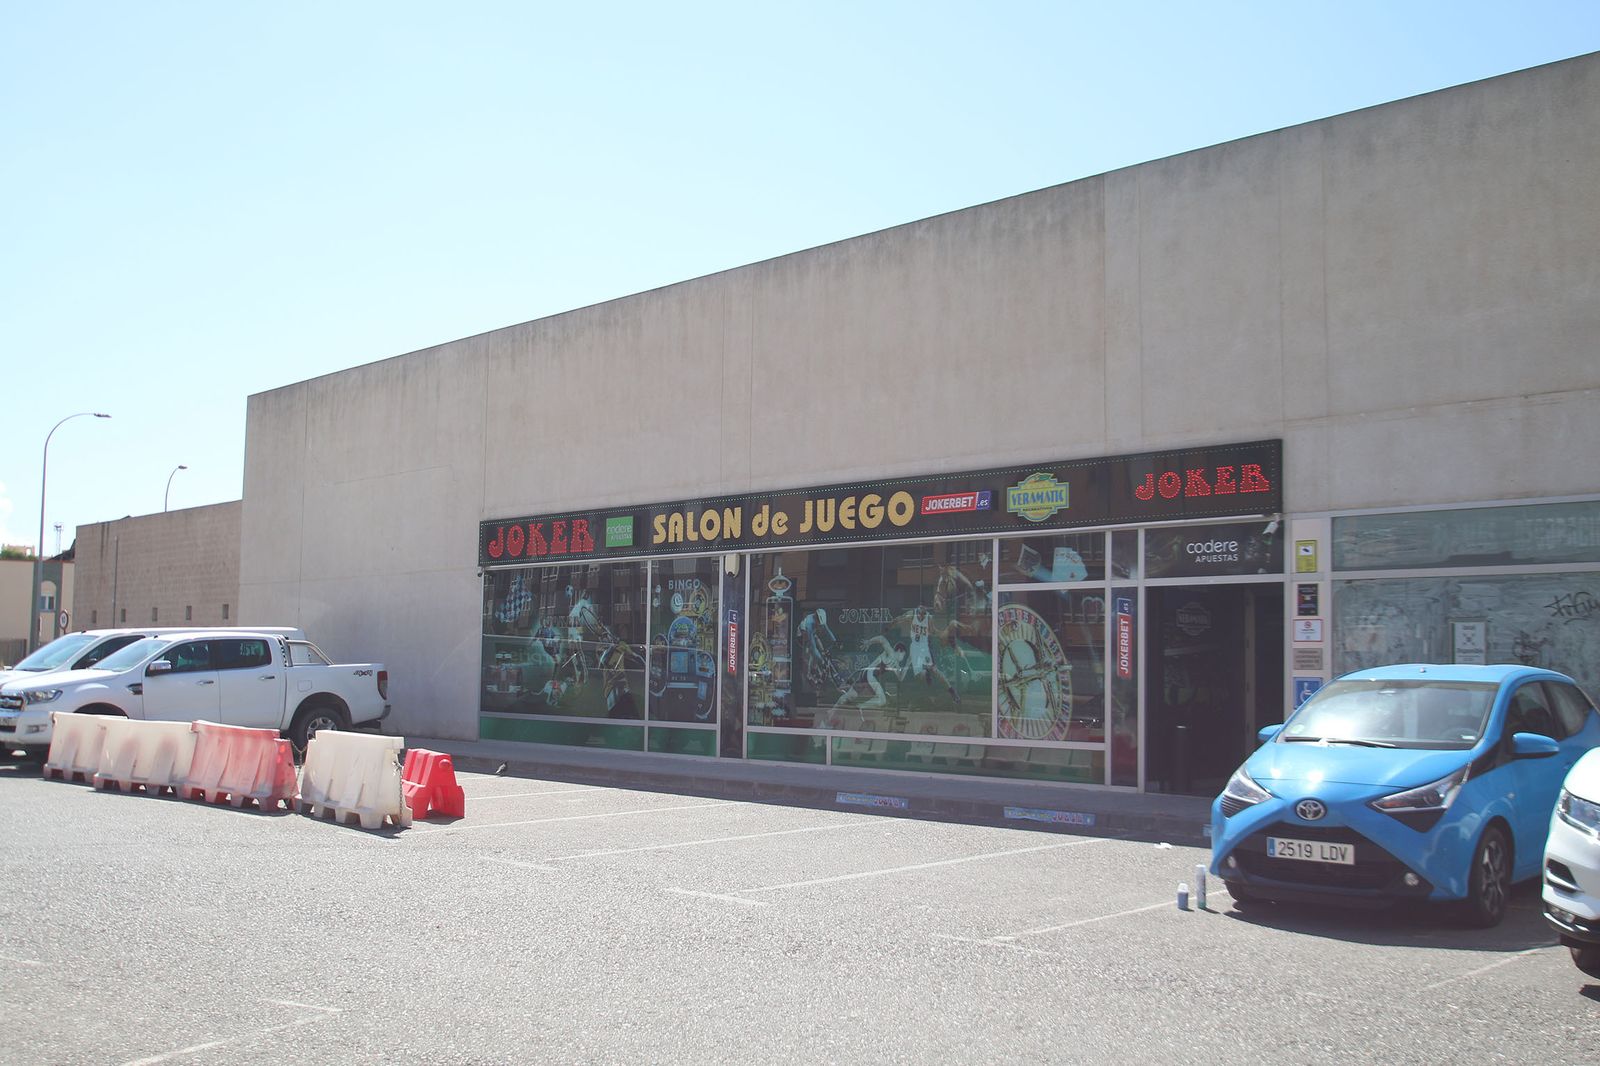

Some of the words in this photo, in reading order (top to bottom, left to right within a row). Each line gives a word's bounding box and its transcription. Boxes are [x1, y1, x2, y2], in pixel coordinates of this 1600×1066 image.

[1135, 463, 1270, 501] JOKER
[925, 496, 974, 512] JOKERBET
[652, 506, 742, 544] SALON
[751, 504, 790, 538] de
[799, 490, 915, 534] JUEGO
[487, 518, 595, 559] JOKER
[1186, 539, 1239, 554] codere
[1195, 553, 1239, 563] APUESTAS
[668, 578, 701, 590] BINGO
[838, 607, 894, 624] JOKER
[728, 626, 738, 671] JOKERBET
[1119, 619, 1130, 674] JOKERBET
[1277, 841, 1313, 859] 2519
[1320, 844, 1349, 862] LDV
